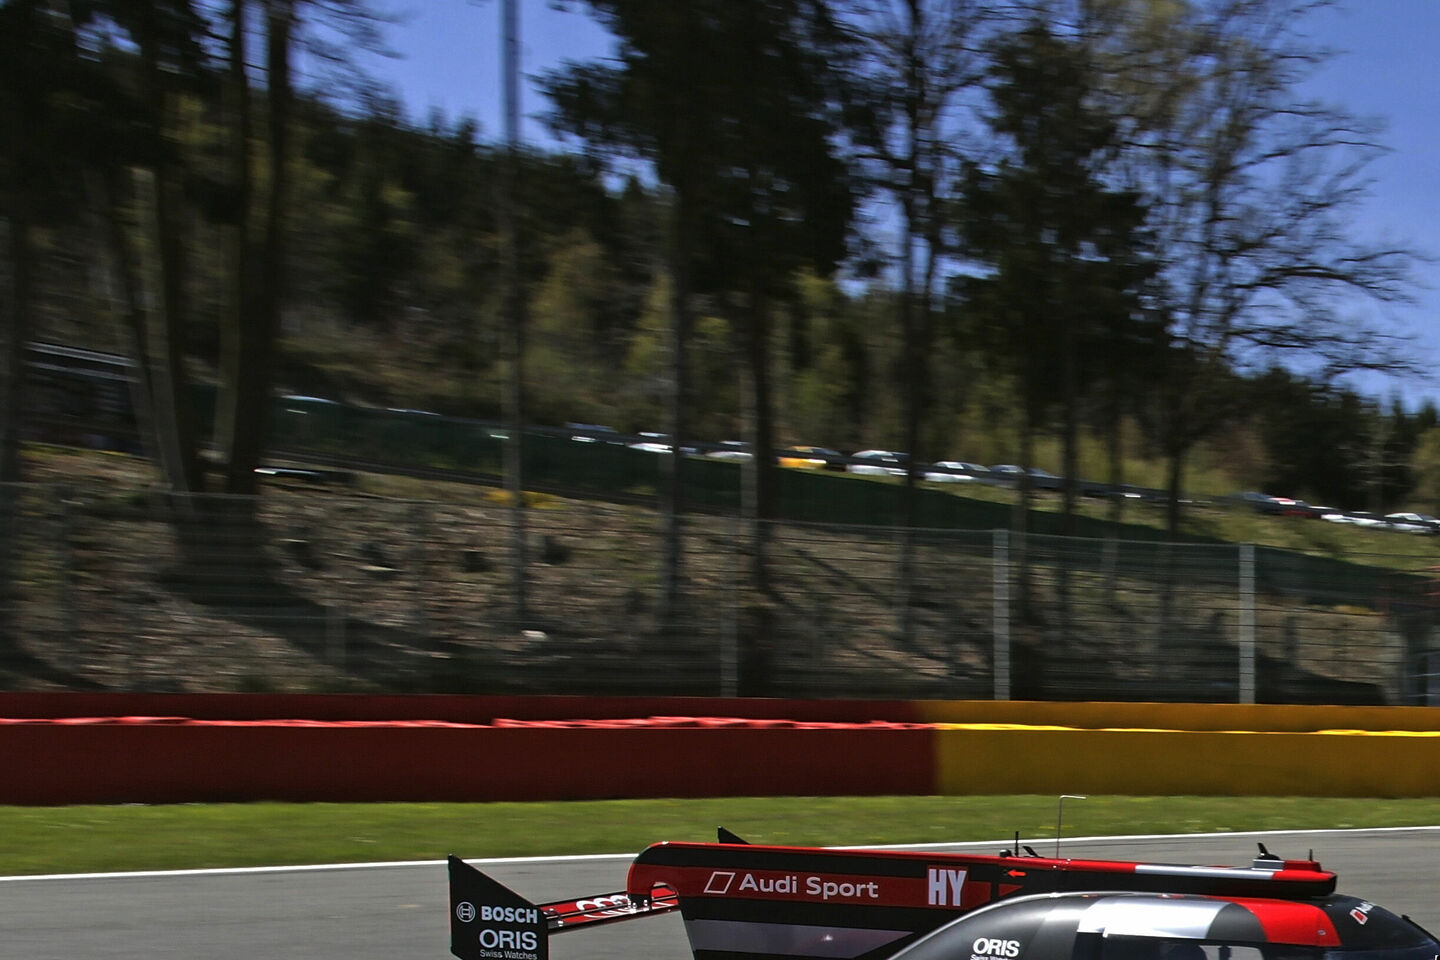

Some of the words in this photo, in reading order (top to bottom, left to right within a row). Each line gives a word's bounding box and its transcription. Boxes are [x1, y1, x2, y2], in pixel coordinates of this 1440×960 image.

[738, 873, 798, 894] Audi
[806, 876, 879, 900] Sport
[928, 869, 968, 906] HY
[481, 905, 538, 924] BOSCH
[479, 929, 538, 951] ORIS
[973, 937, 1021, 958] ORIS
[480, 949, 502, 959] Swiss
[504, 950, 538, 960] Watches
